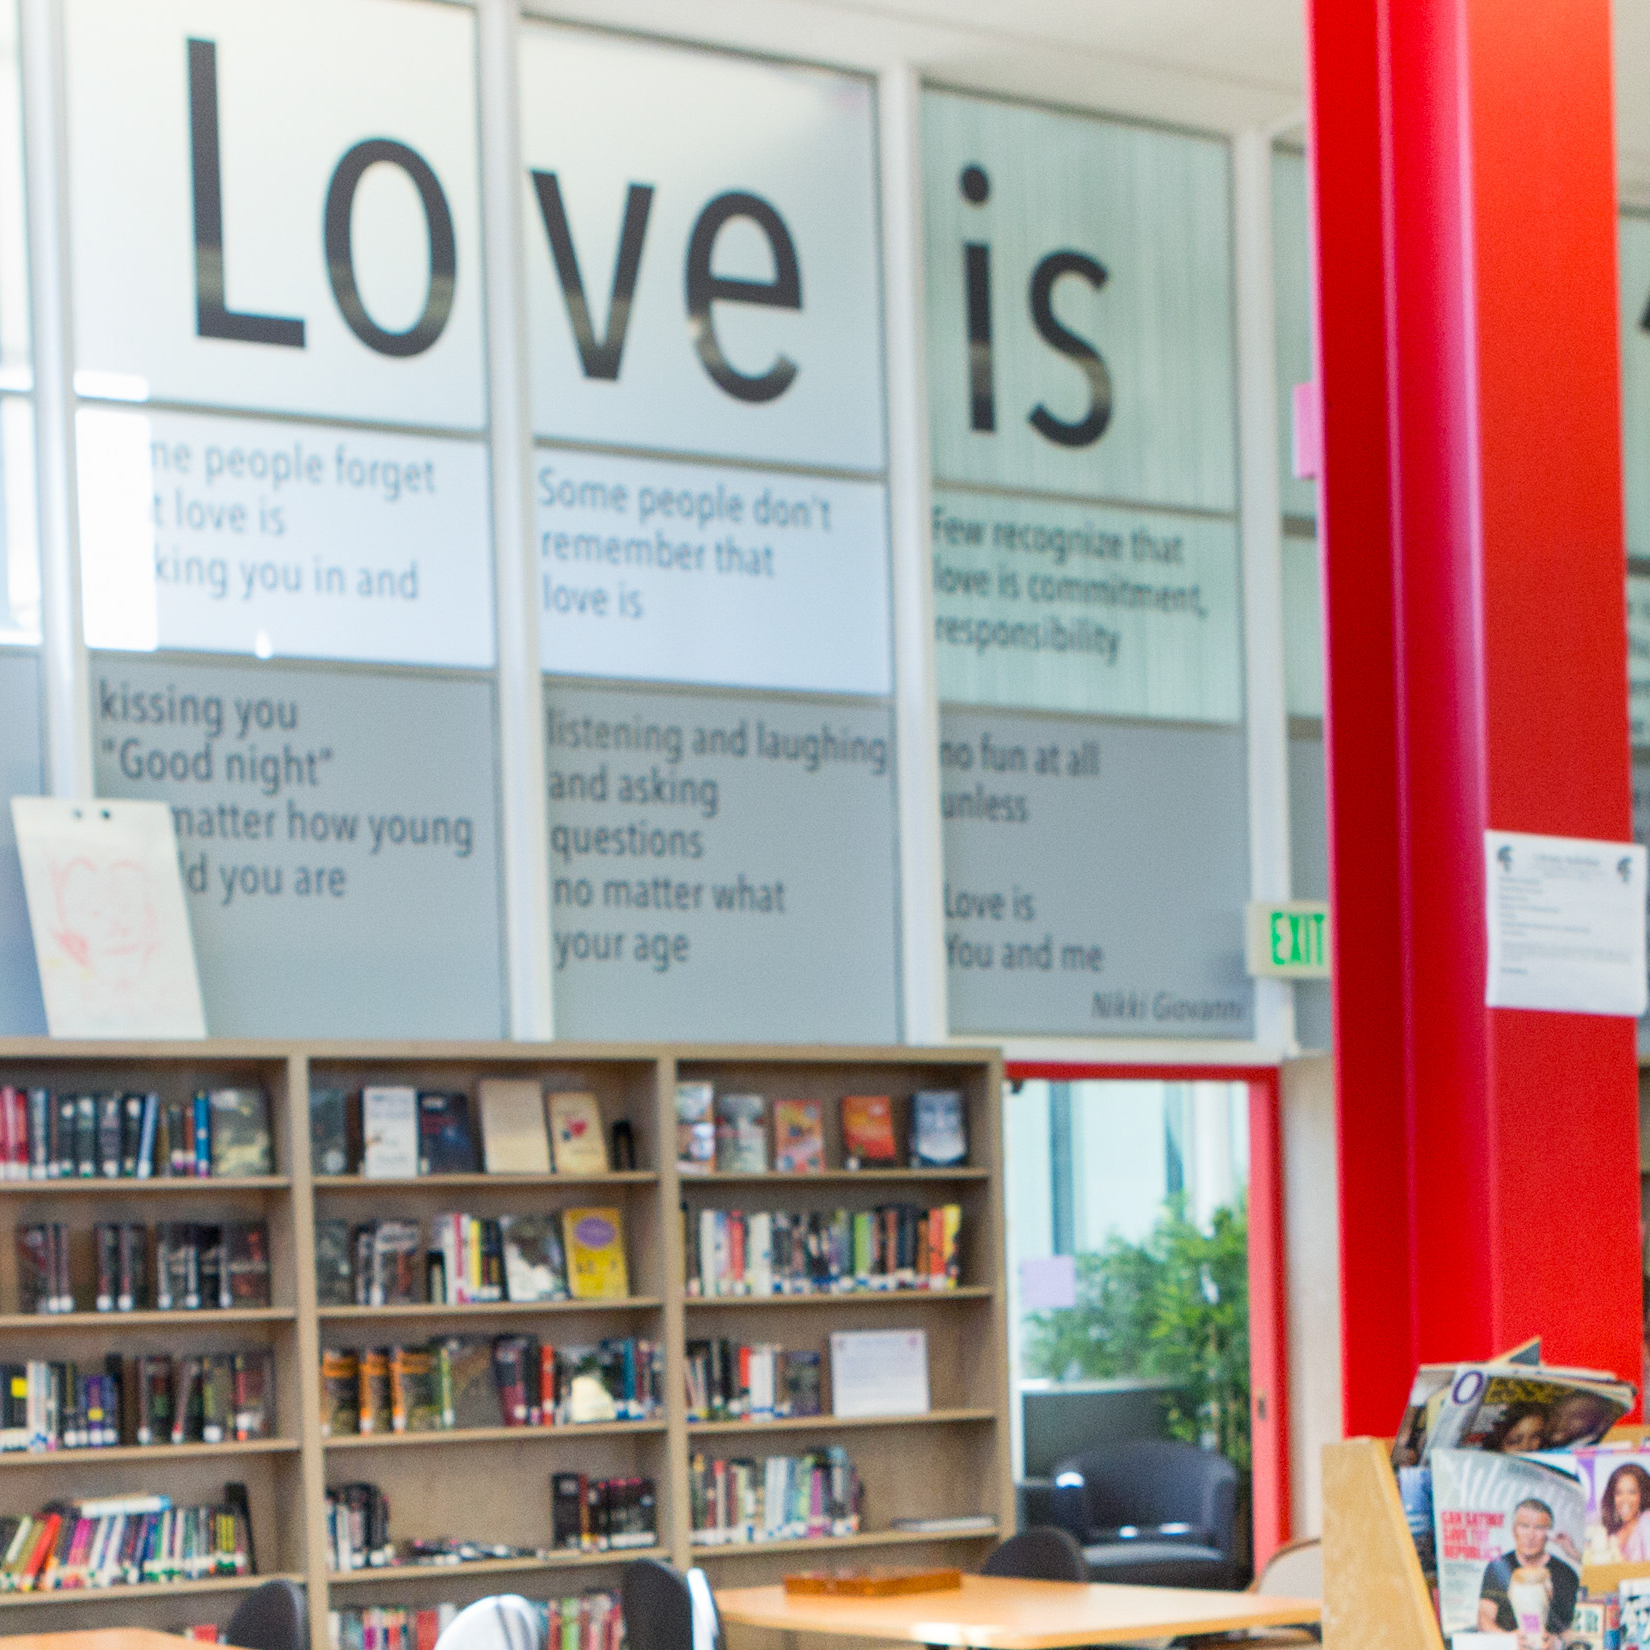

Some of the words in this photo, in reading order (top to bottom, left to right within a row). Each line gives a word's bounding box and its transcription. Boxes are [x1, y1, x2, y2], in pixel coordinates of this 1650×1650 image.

[186, 36, 803, 404] Love
[959, 164, 1113, 450] is
[205, 443, 323, 487] people
[334, 447, 435, 501] forget
[174, 493, 247, 531] love
[259, 499, 285, 536] is
[539, 468, 627, 517] Some
[638, 482, 743, 527] people
[753, 487, 832, 531] don't
[542, 531, 704, 574] remember
[715, 538, 774, 579] that
[931, 507, 985, 545] Few
[992, 519, 1124, 565] recognize
[1131, 528, 1183, 564] that
[238, 559, 302, 602] you
[314, 557, 345, 593] in
[357, 560, 418, 600] and
[544, 575, 609, 617] love
[620, 582, 643, 621] is
[934, 557, 990, 599] love
[998, 564, 1020, 601] is
[1028, 570, 1208, 619] commitment,
[935, 611, 1119, 665] responsibility
[98, 680, 224, 738] kissing
[234, 695, 298, 738] you
[101, 737, 214, 783] "Good
[226, 742, 334, 796] night"
[549, 707, 683, 763] listening
[692, 721, 746, 759] and
[757, 721, 888, 775] laughing
[940, 739, 973, 771] no
[981, 734, 1026, 772] fun
[1034, 743, 1059, 776] at
[1066, 739, 1100, 778] all
[548, 763, 609, 804] and
[618, 765, 719, 817] asking
[942, 785, 1029, 823] unless
[287, 804, 358, 842] how
[369, 814, 474, 858] young
[551, 820, 704, 860] questions
[220, 863, 282, 905] you
[295, 867, 347, 898] are
[554, 879, 593, 909] no
[604, 879, 704, 913] matter
[712, 879, 786, 915] what
[944, 883, 1006, 919] Love
[1013, 885, 1034, 921] is
[553, 932, 625, 970] your
[635, 934, 690, 972] age
[946, 937, 993, 969] You
[1001, 933, 1050, 970] and
[1061, 939, 1102, 972] me
[1271, 912, 1325, 966] EXIT
